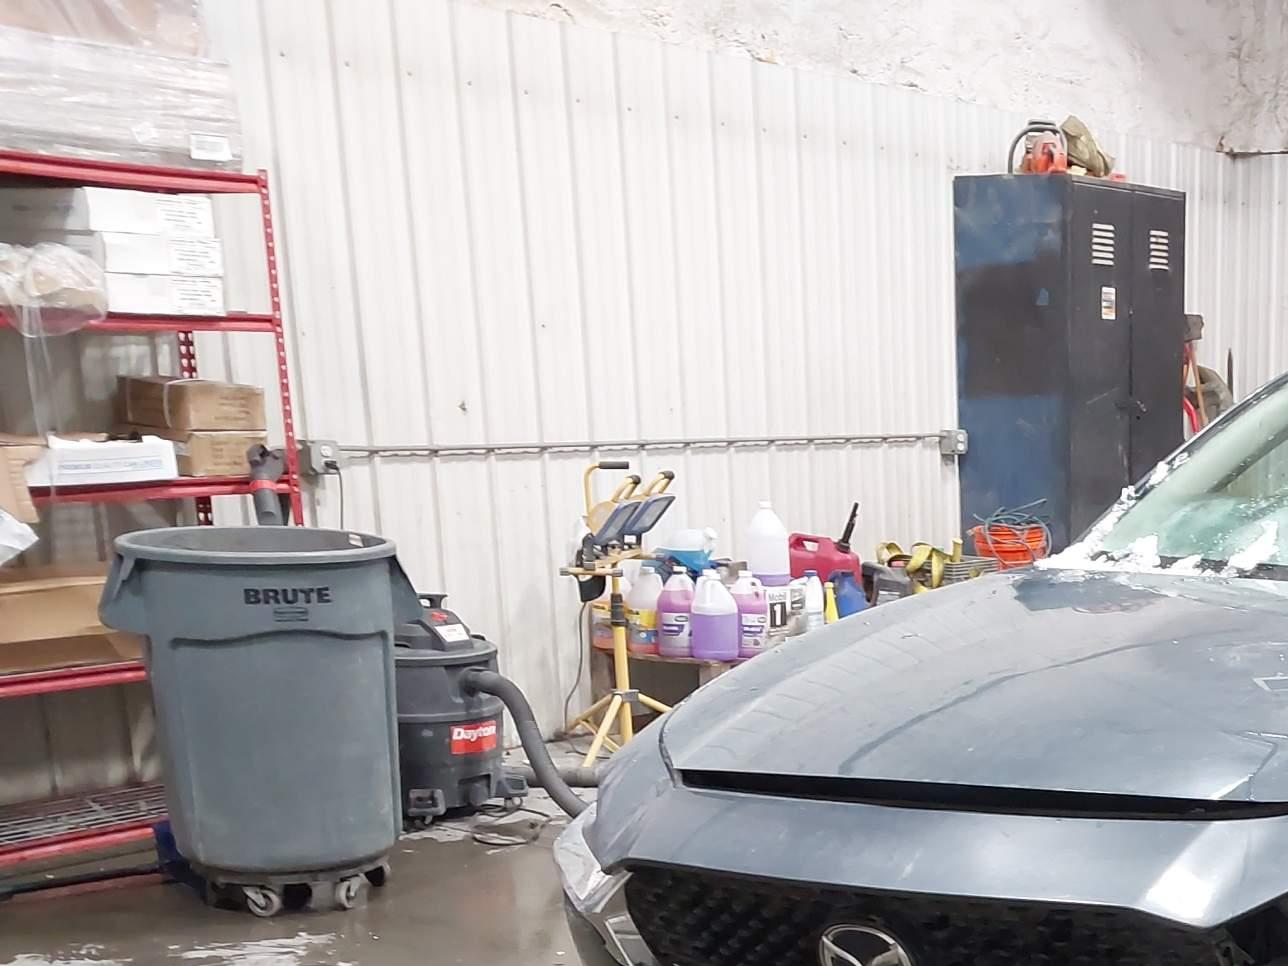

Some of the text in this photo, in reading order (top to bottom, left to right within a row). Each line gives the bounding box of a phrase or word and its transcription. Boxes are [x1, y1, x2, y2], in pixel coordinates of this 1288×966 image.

[243, 587, 332, 605] BRUTE
[768, 591, 787, 601] Mobil
[452, 725, 496, 742] Dayton
